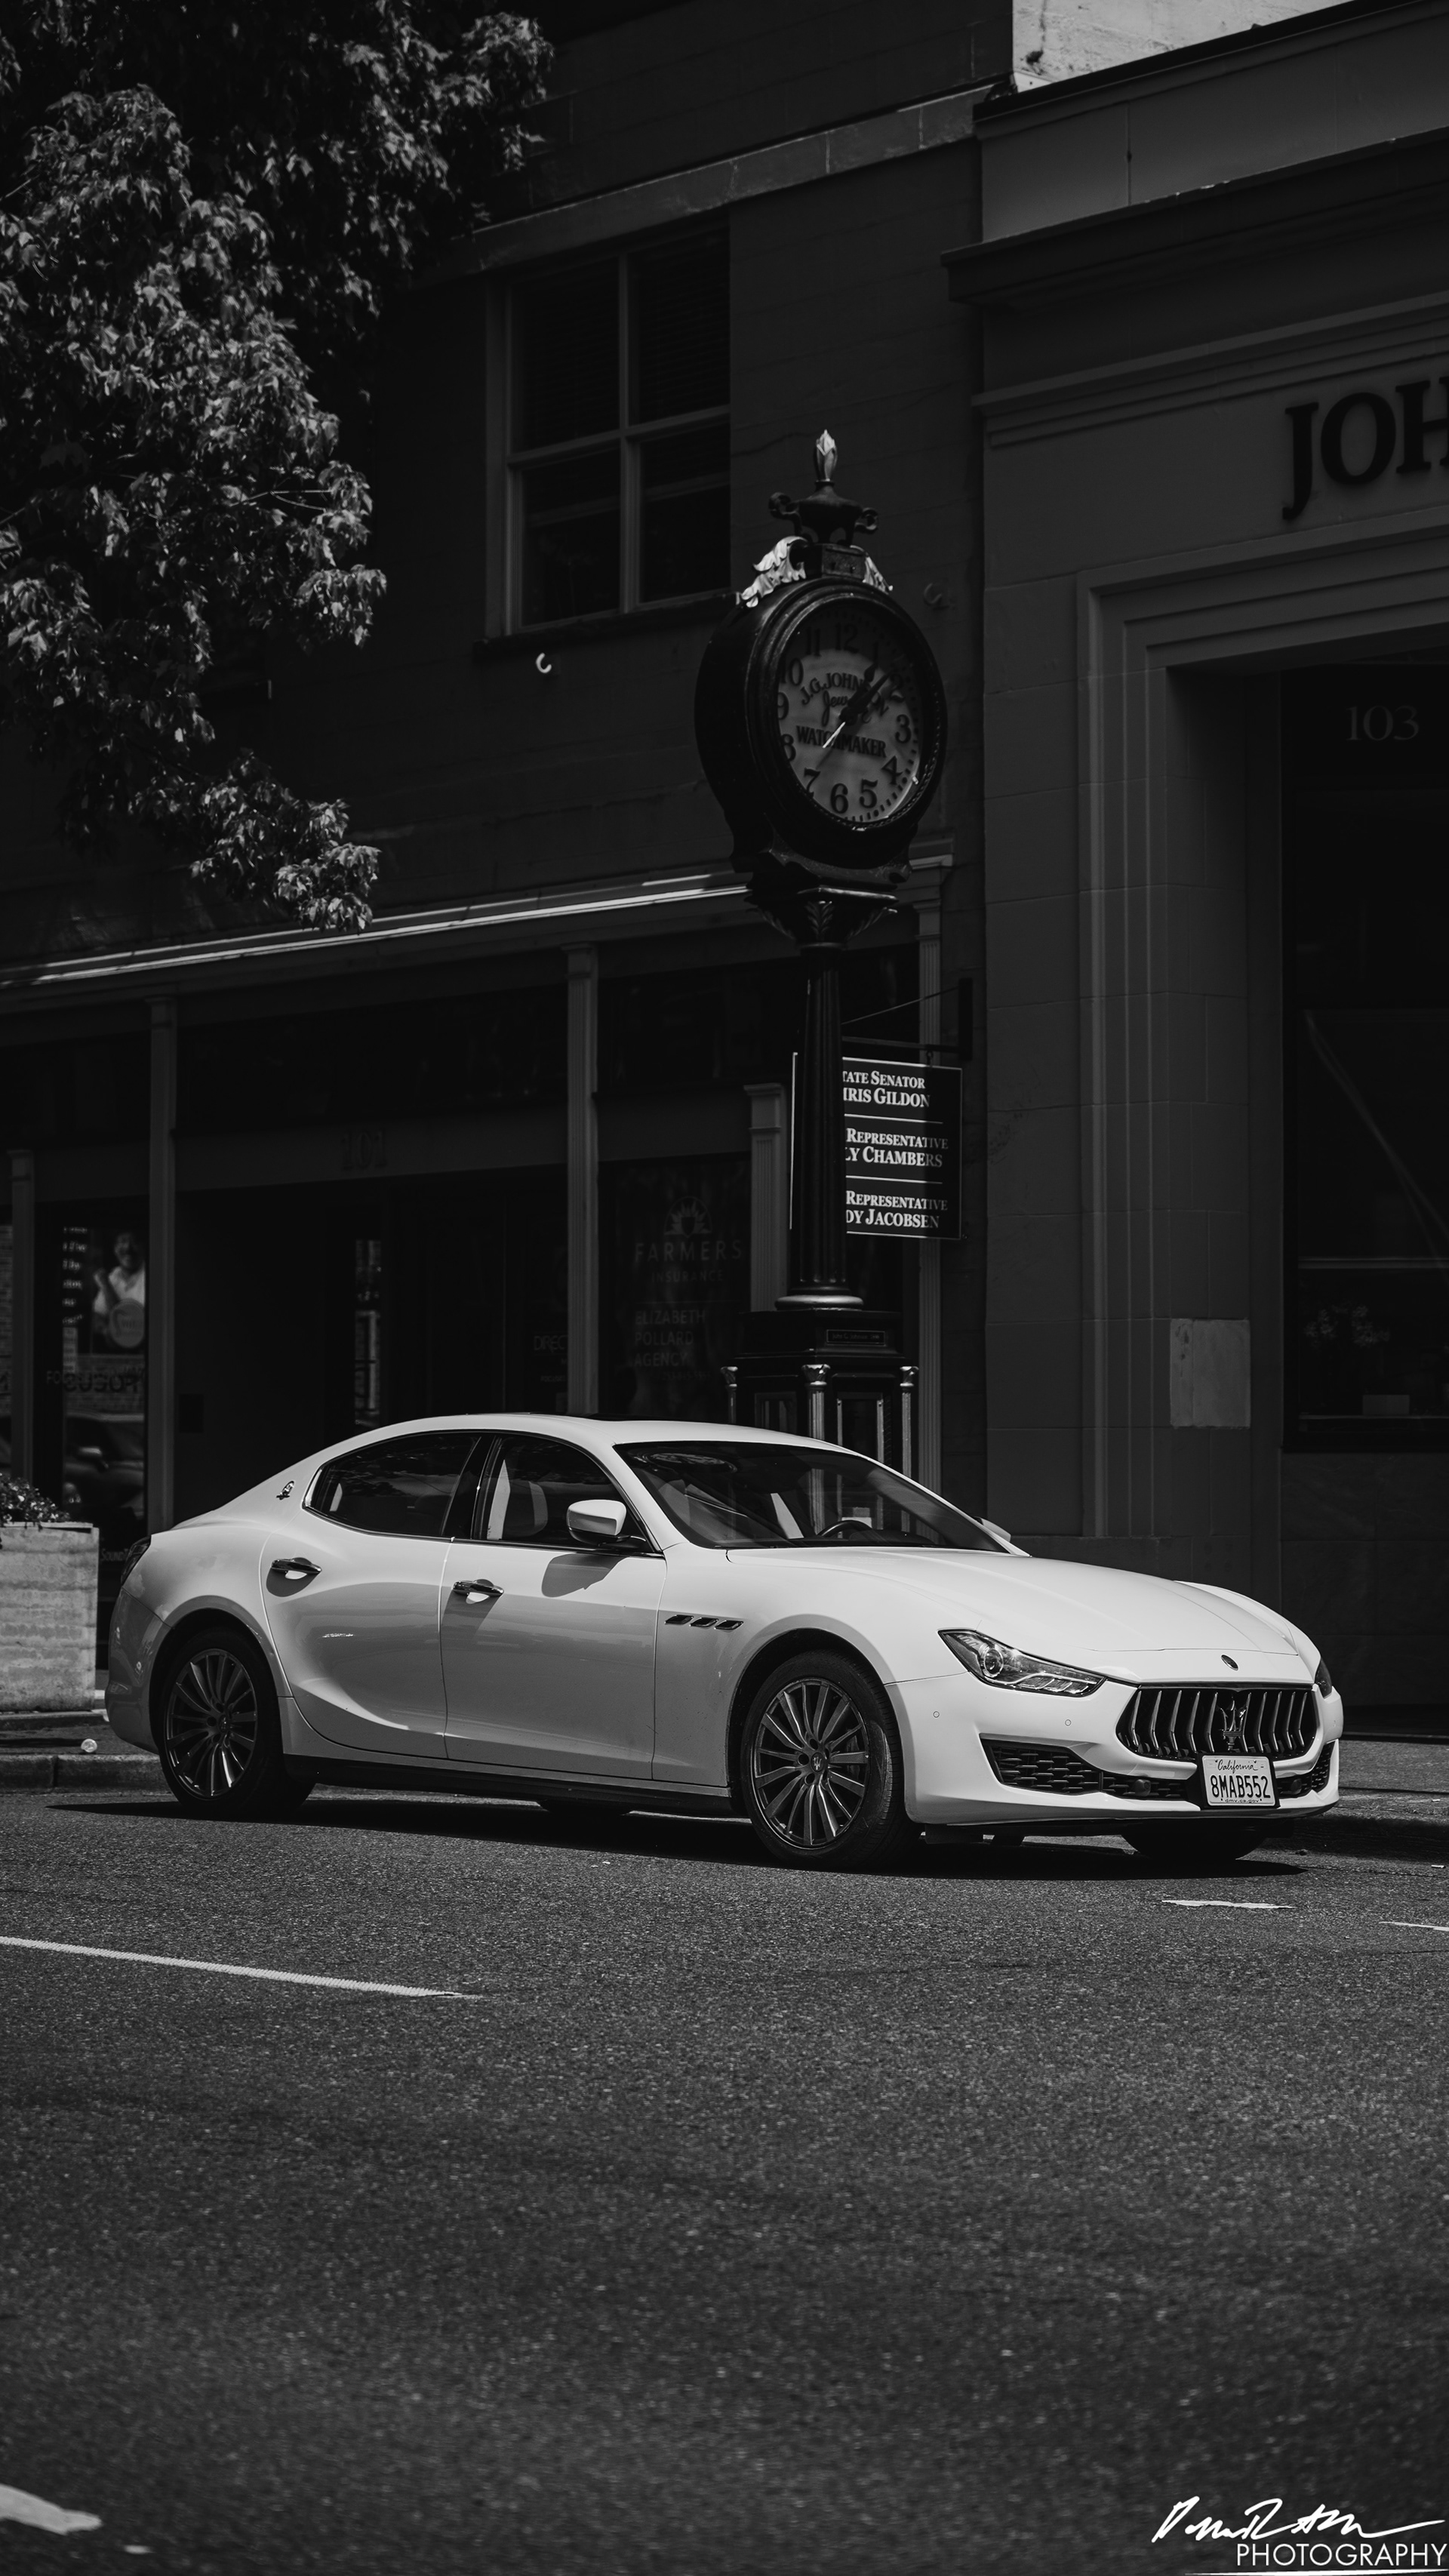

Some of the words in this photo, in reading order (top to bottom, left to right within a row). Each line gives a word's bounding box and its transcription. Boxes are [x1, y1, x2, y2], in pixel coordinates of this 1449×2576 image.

[1282, 376, 1449, 520] JOH
[804, 626, 822, 657] 11
[835, 622, 860, 654] 12
[895, 714, 911, 743] 3
[1346, 705, 1420, 740] 103
[781, 734, 796, 762] 8
[881, 756, 903, 785] 4
[804, 767, 820, 799] 7
[859, 778, 878, 808] 5
[831, 783, 848, 814] 6
[871, 1069, 925, 1089] SENATOR
[873, 1088, 930, 1107] GILDON
[341, 1127, 387, 1171] 101
[846, 1128, 949, 1149] REPRESENTATIVE
[863, 1146, 943, 1168] CHAMBERS
[846, 1190, 948, 1210] REPRESENTATIVE
[865, 1208, 940, 1228] JACOBSEN
[635, 1239, 742, 1263] FARMERS
[651, 1269, 724, 1283] INSURANCE
[635, 1309, 706, 1325] ELIZABETH
[533, 1334, 568, 1352] DIREC
[635, 1331, 694, 1346] POLLARD
[634, 1352, 689, 1367] AGENCY
[1217, 1759, 1258, 1774] California
[1210, 1774, 1271, 1798] 8MAB552
